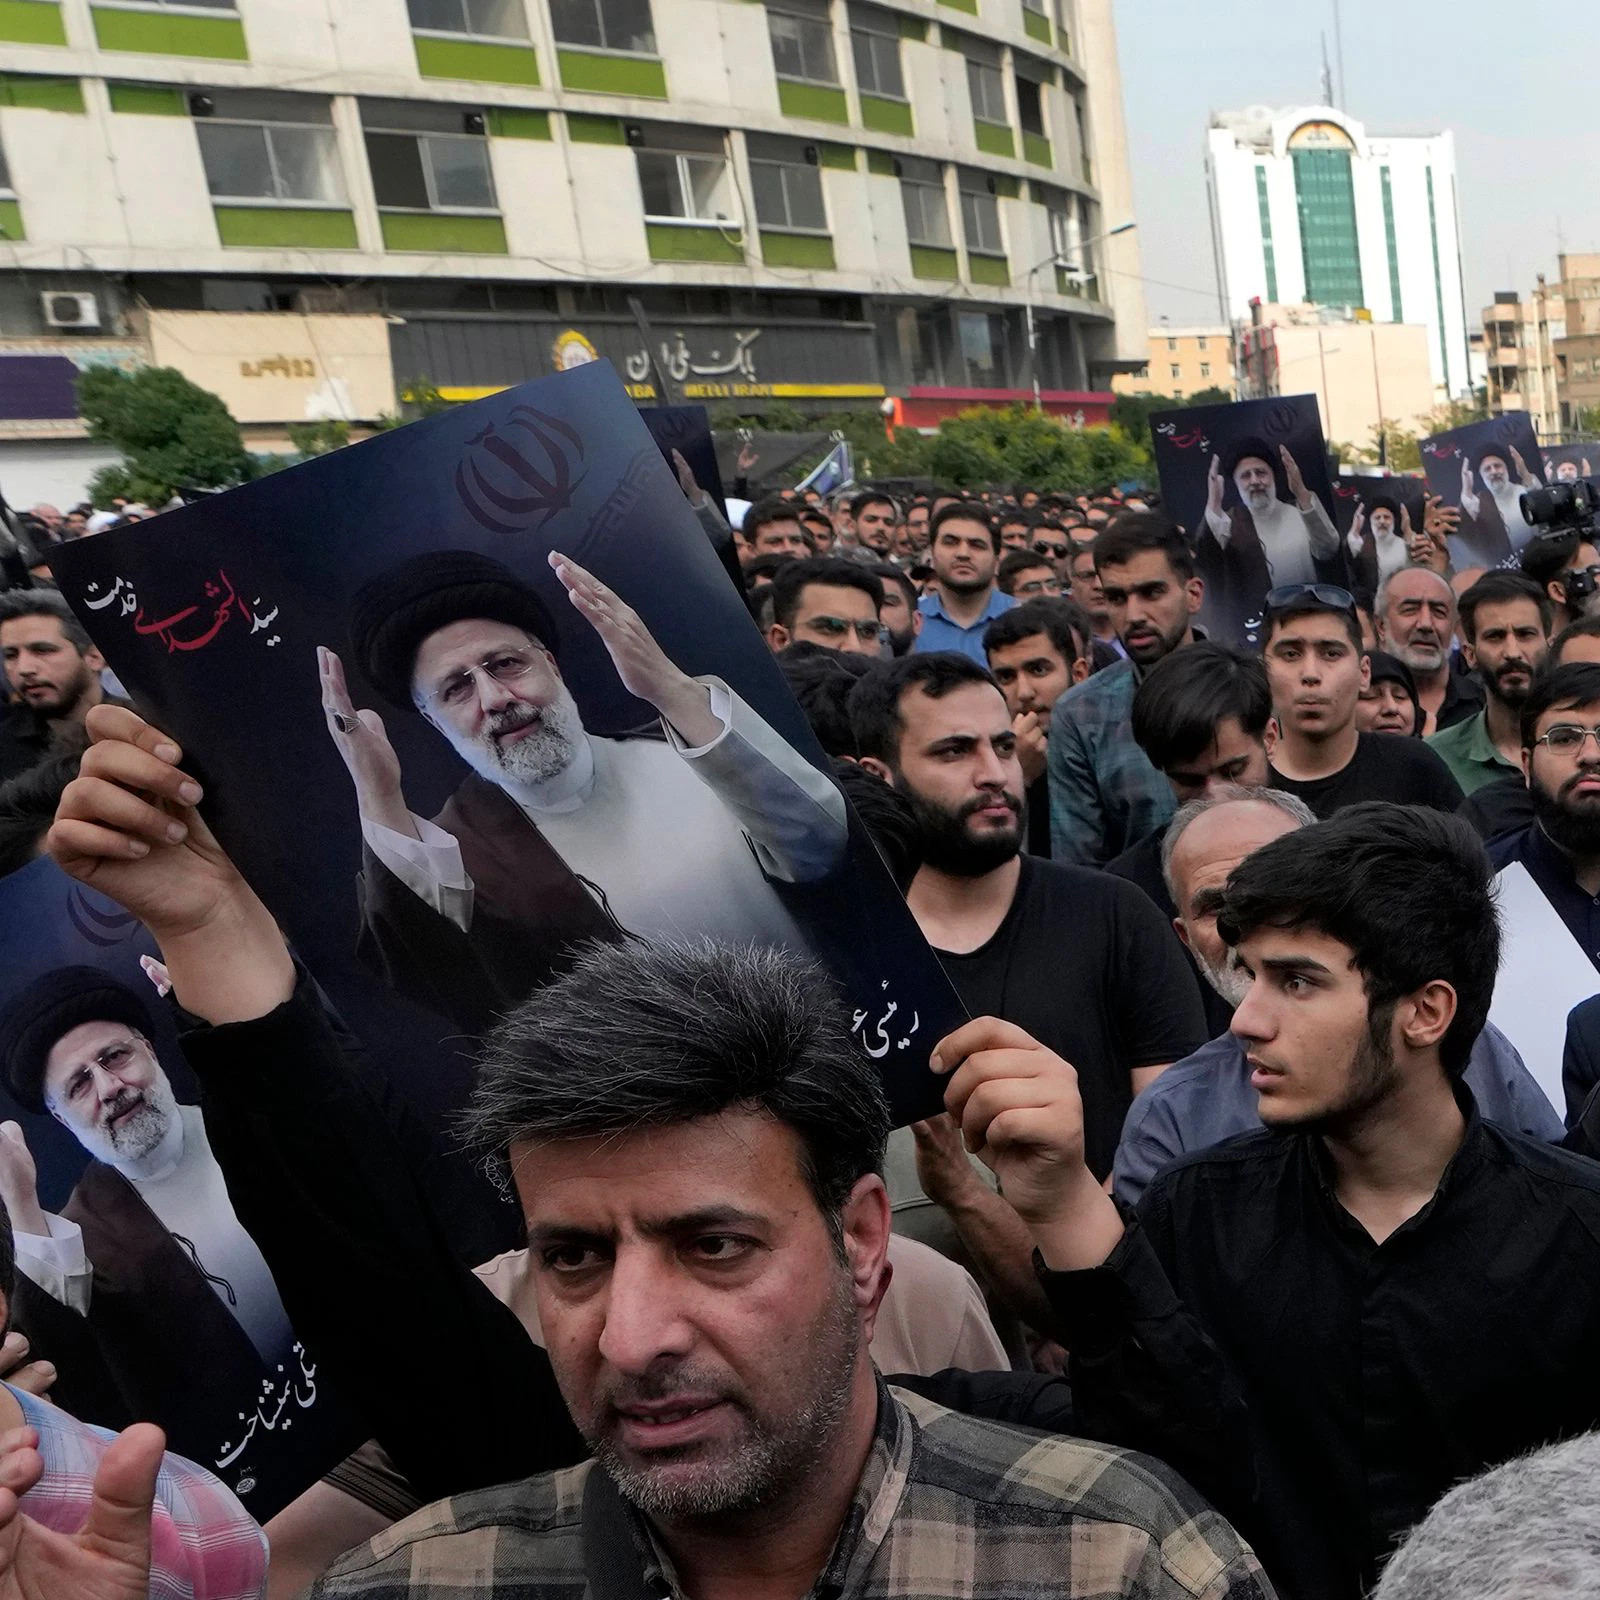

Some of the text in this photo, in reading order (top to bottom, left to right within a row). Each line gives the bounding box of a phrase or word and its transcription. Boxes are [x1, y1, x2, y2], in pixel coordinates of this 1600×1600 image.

[683, 383, 729, 398] MELLI
[732, 384, 771, 398] IRAN
[84, 575, 137, 617] خدمت
